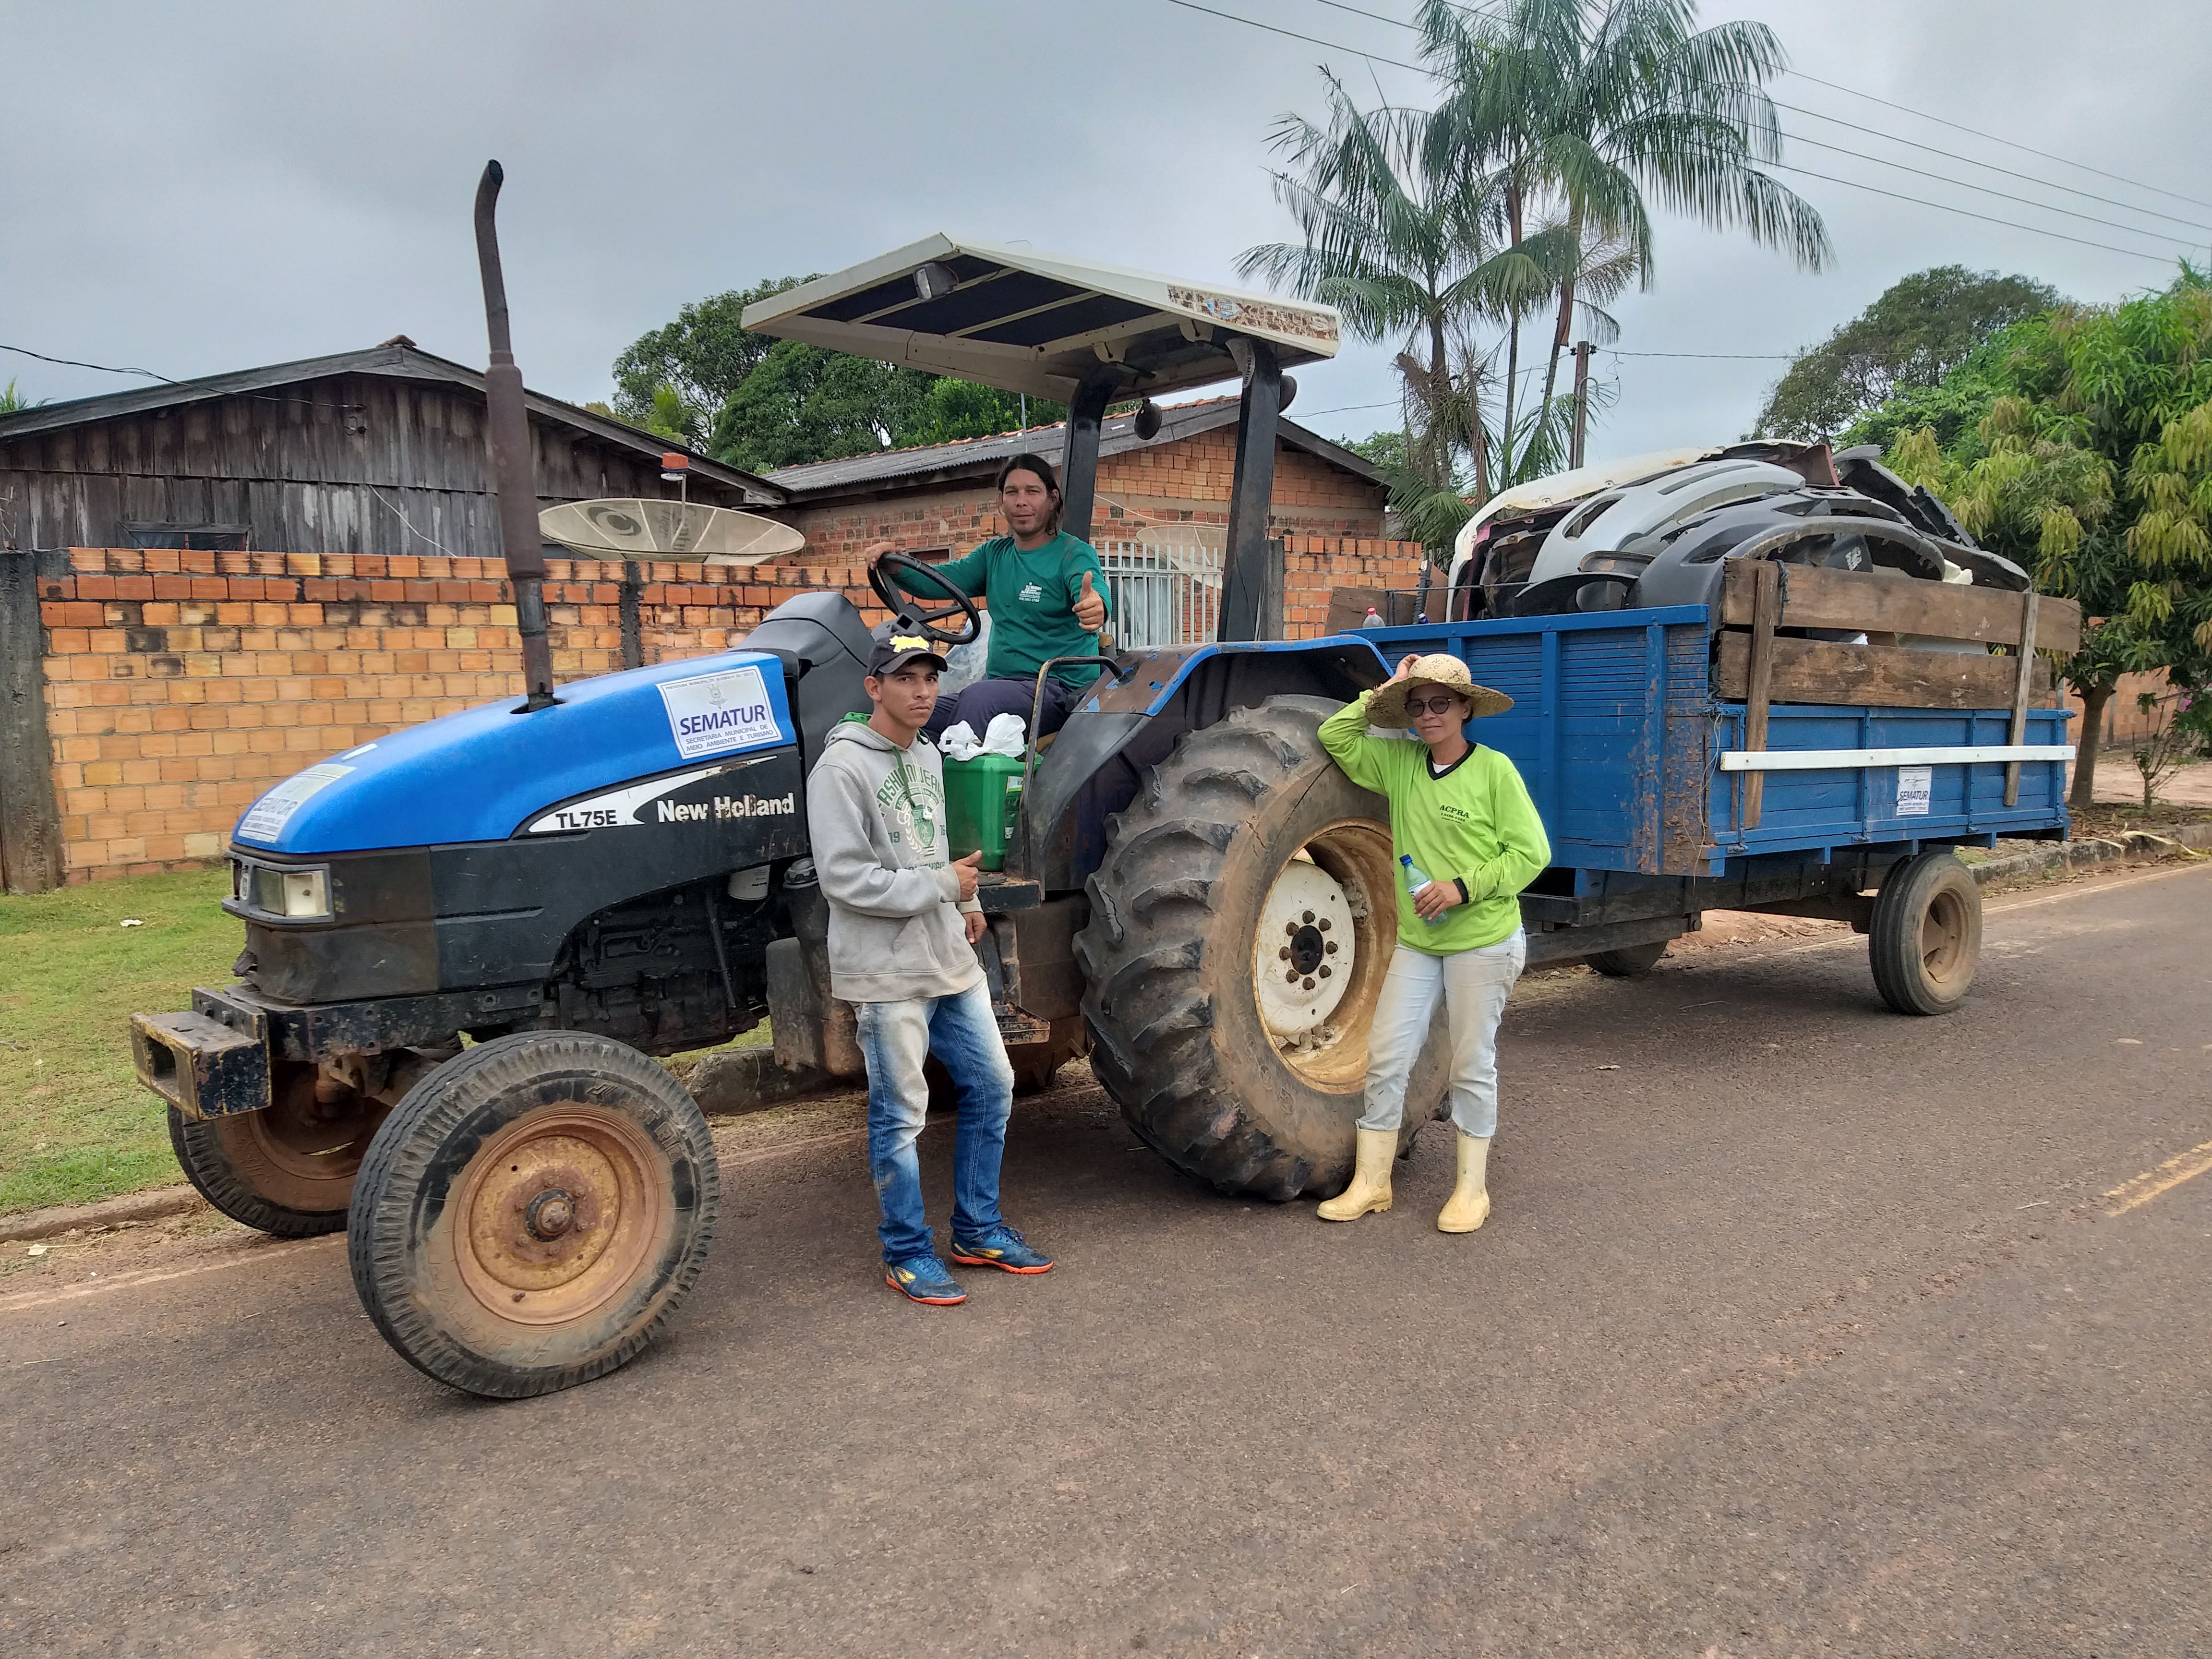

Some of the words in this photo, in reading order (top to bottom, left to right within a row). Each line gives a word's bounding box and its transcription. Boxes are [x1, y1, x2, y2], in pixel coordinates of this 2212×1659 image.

[680, 705, 766, 735] SEMATUR
[686, 733, 722, 744] SECRETARIA
[725, 726, 757, 736] MUNICIPAL
[707, 737, 737, 747] AMBIENTE
[747, 730, 773, 740] TURISMO
[1899, 791, 1928, 801] SEMATUR
[657, 799, 709, 823] New
[714, 793, 794, 818] Holland
[1439, 805, 1470, 819] ACPRA
[555, 810, 617, 829] TL75E
